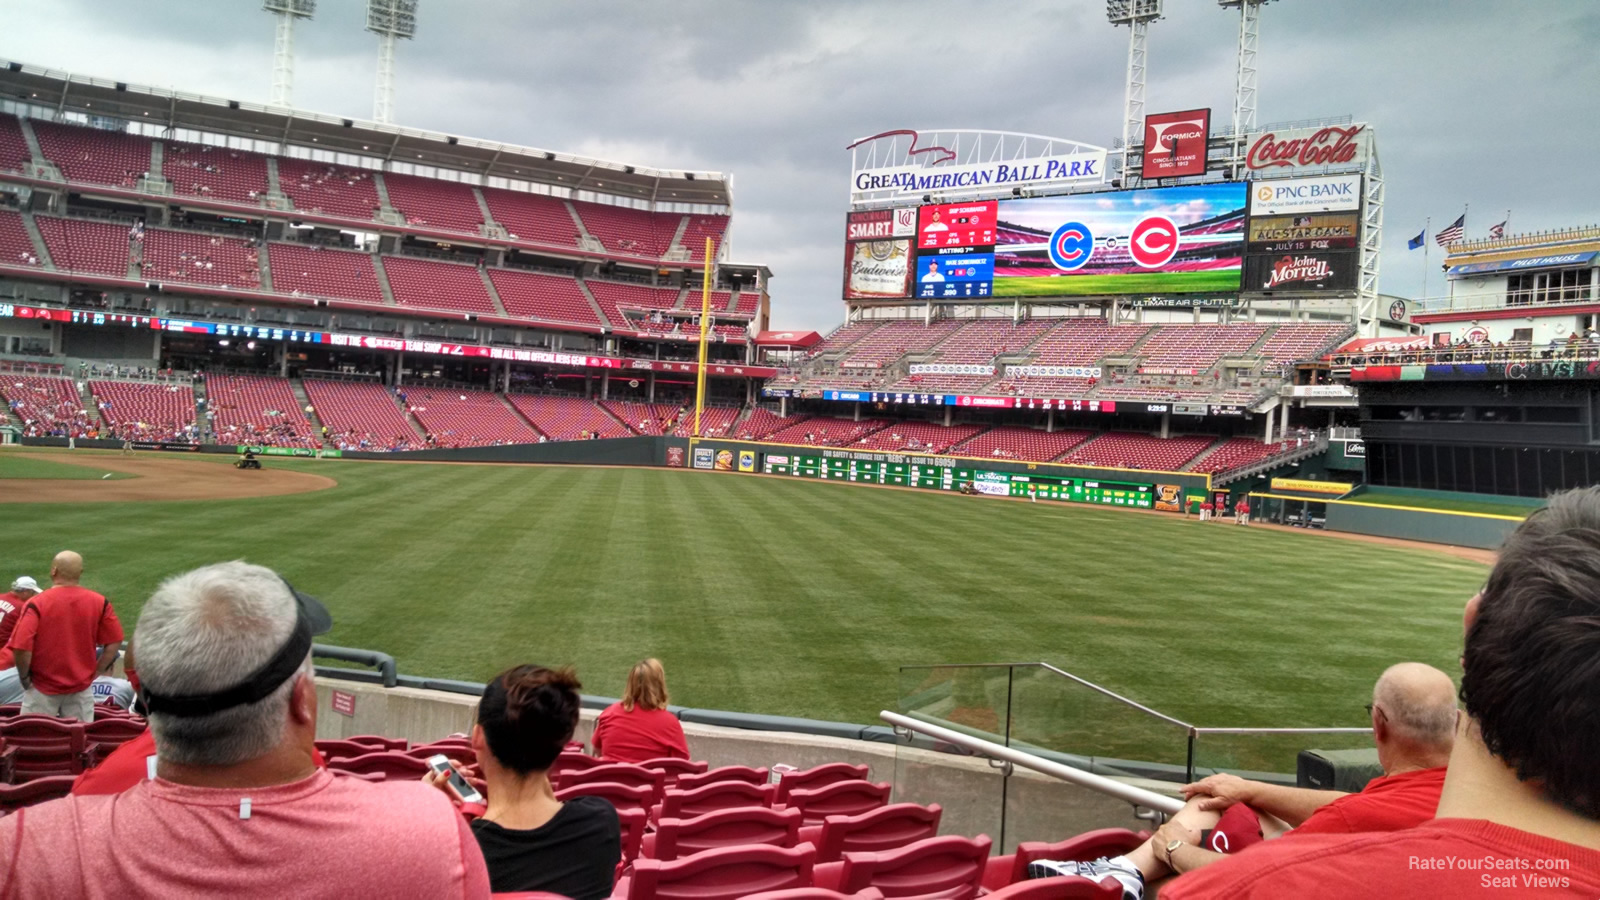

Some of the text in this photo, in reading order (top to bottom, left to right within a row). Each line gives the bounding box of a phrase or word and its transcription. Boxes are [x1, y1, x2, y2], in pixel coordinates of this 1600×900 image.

[1161, 131, 1201, 141] FORMICA
[1246, 125, 1366, 170] Coca-Cola
[856, 159, 1097, 191] GREAT AMERICAN BALL PARK
[1276, 182, 1352, 199] PNC BANK
[849, 221, 892, 238] SMART
[1316, 225, 1352, 237] GAME
[1311, 240, 1329, 248] FOX
[1289, 256, 1316, 268] John
[1512, 254, 1580, 267] PILOT HOUSE
[1263, 261, 1334, 287] Morrell
[1133, 298, 1233, 307] ULTIMATE AIR SHUTTLE
[424, 342, 441, 353] SHOP
[503, 349, 513, 360] ALL
[514, 350, 530, 361] YOUR
